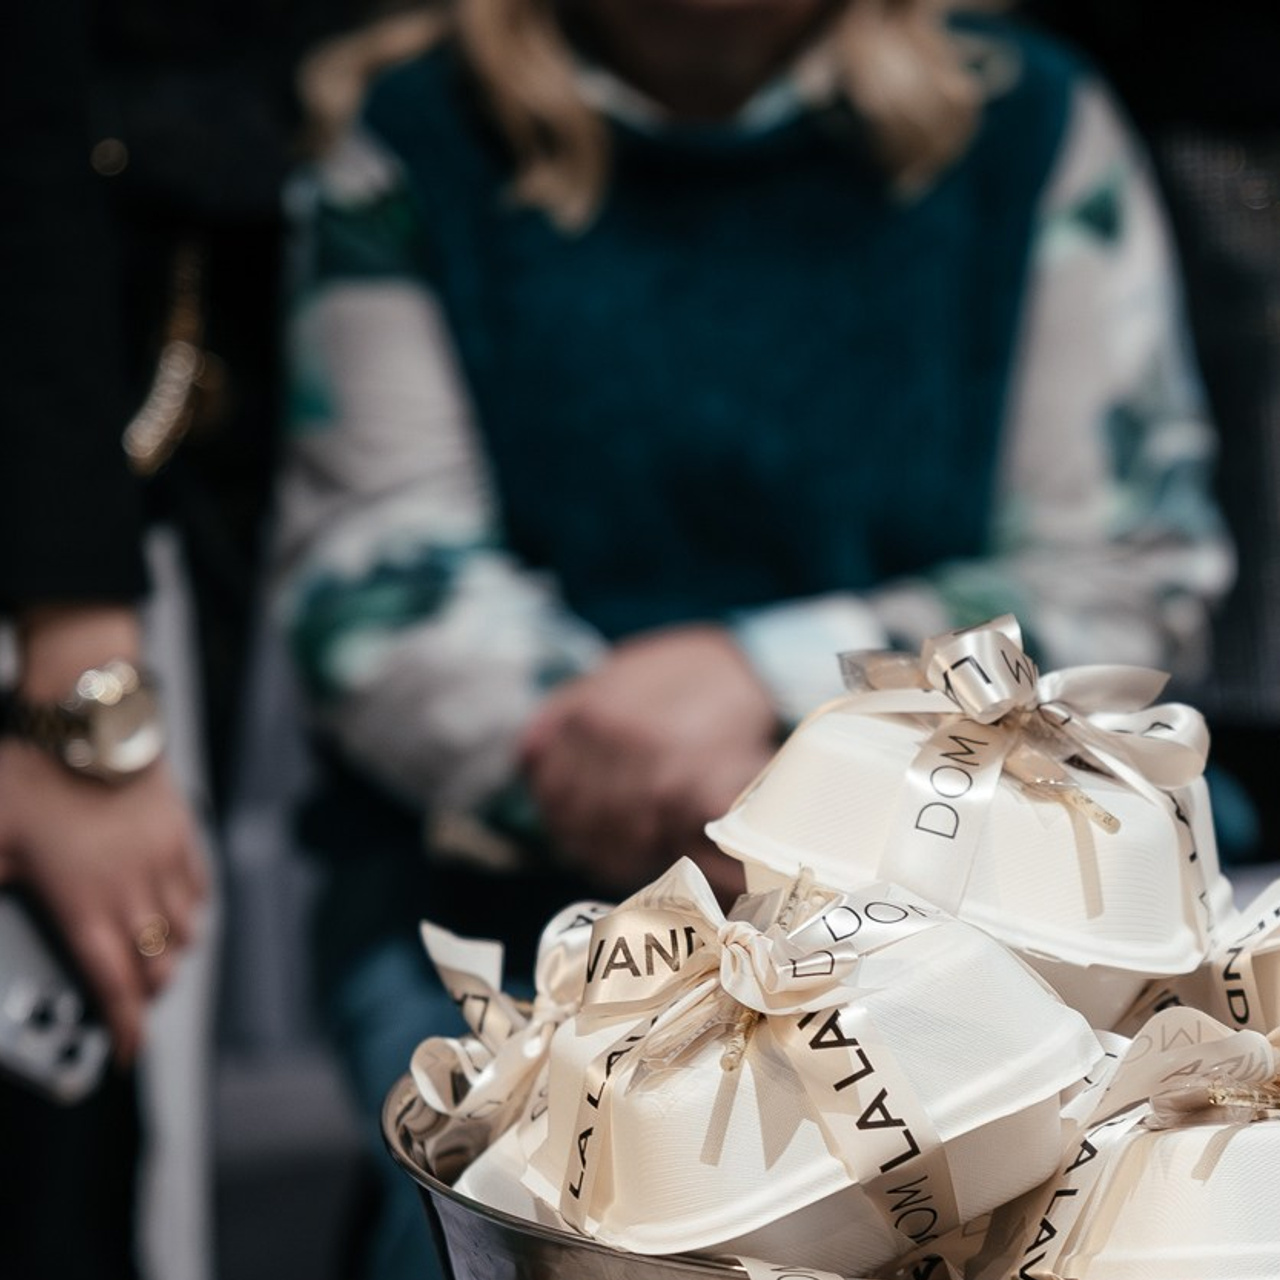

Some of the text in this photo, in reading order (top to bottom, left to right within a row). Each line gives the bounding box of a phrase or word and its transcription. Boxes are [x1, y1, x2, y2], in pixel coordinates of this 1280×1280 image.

[914, 734, 989, 840] DOM
[568, 1127, 594, 1200] LA
[855, 1087, 922, 1174] LA
